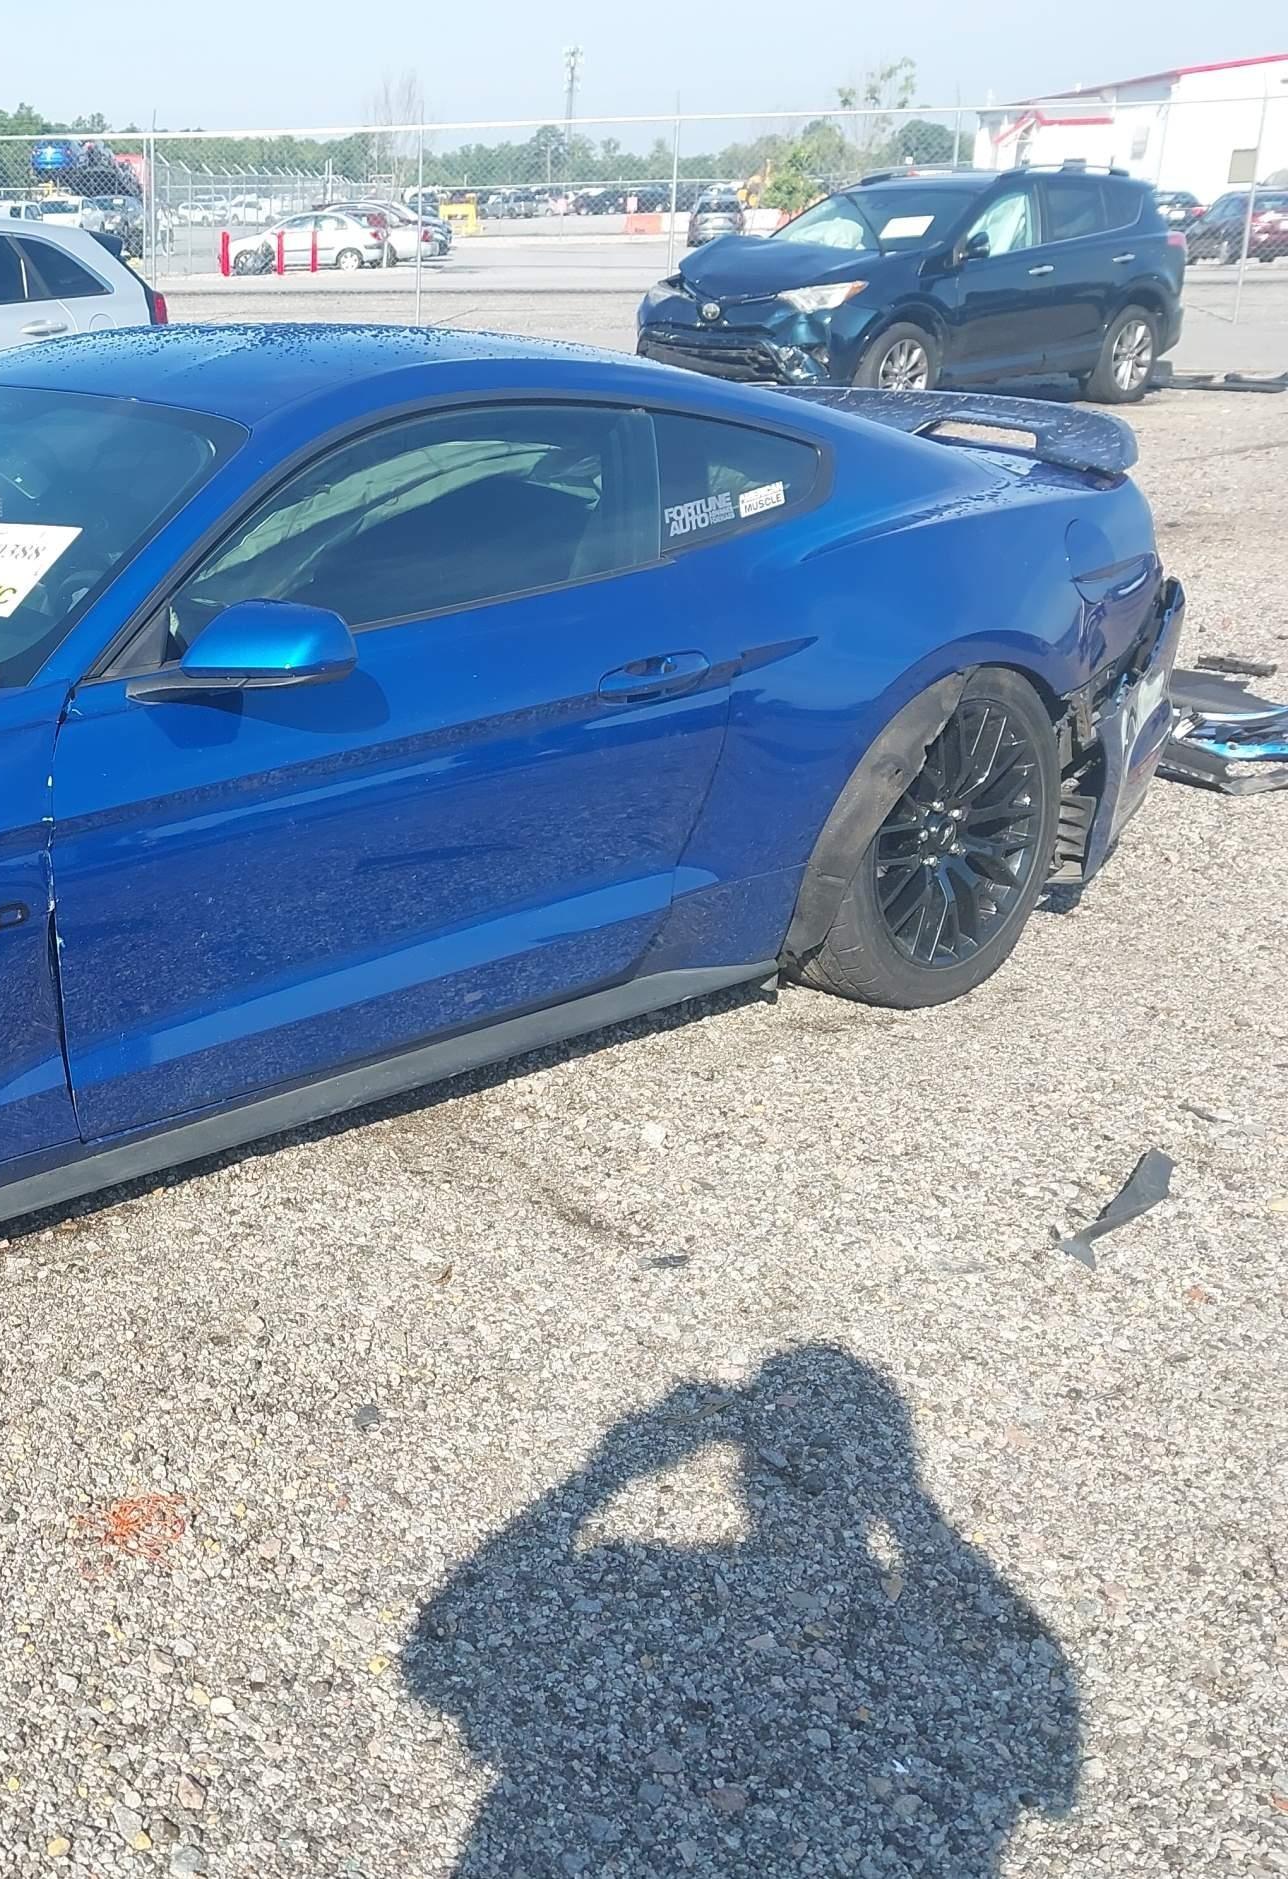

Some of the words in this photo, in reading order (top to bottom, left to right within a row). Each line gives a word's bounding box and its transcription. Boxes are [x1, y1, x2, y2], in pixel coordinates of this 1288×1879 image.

[664, 492, 732, 524] FORTUNE
[744, 493, 783, 514] MUSCLE
[669, 512, 709, 537] AUTO
